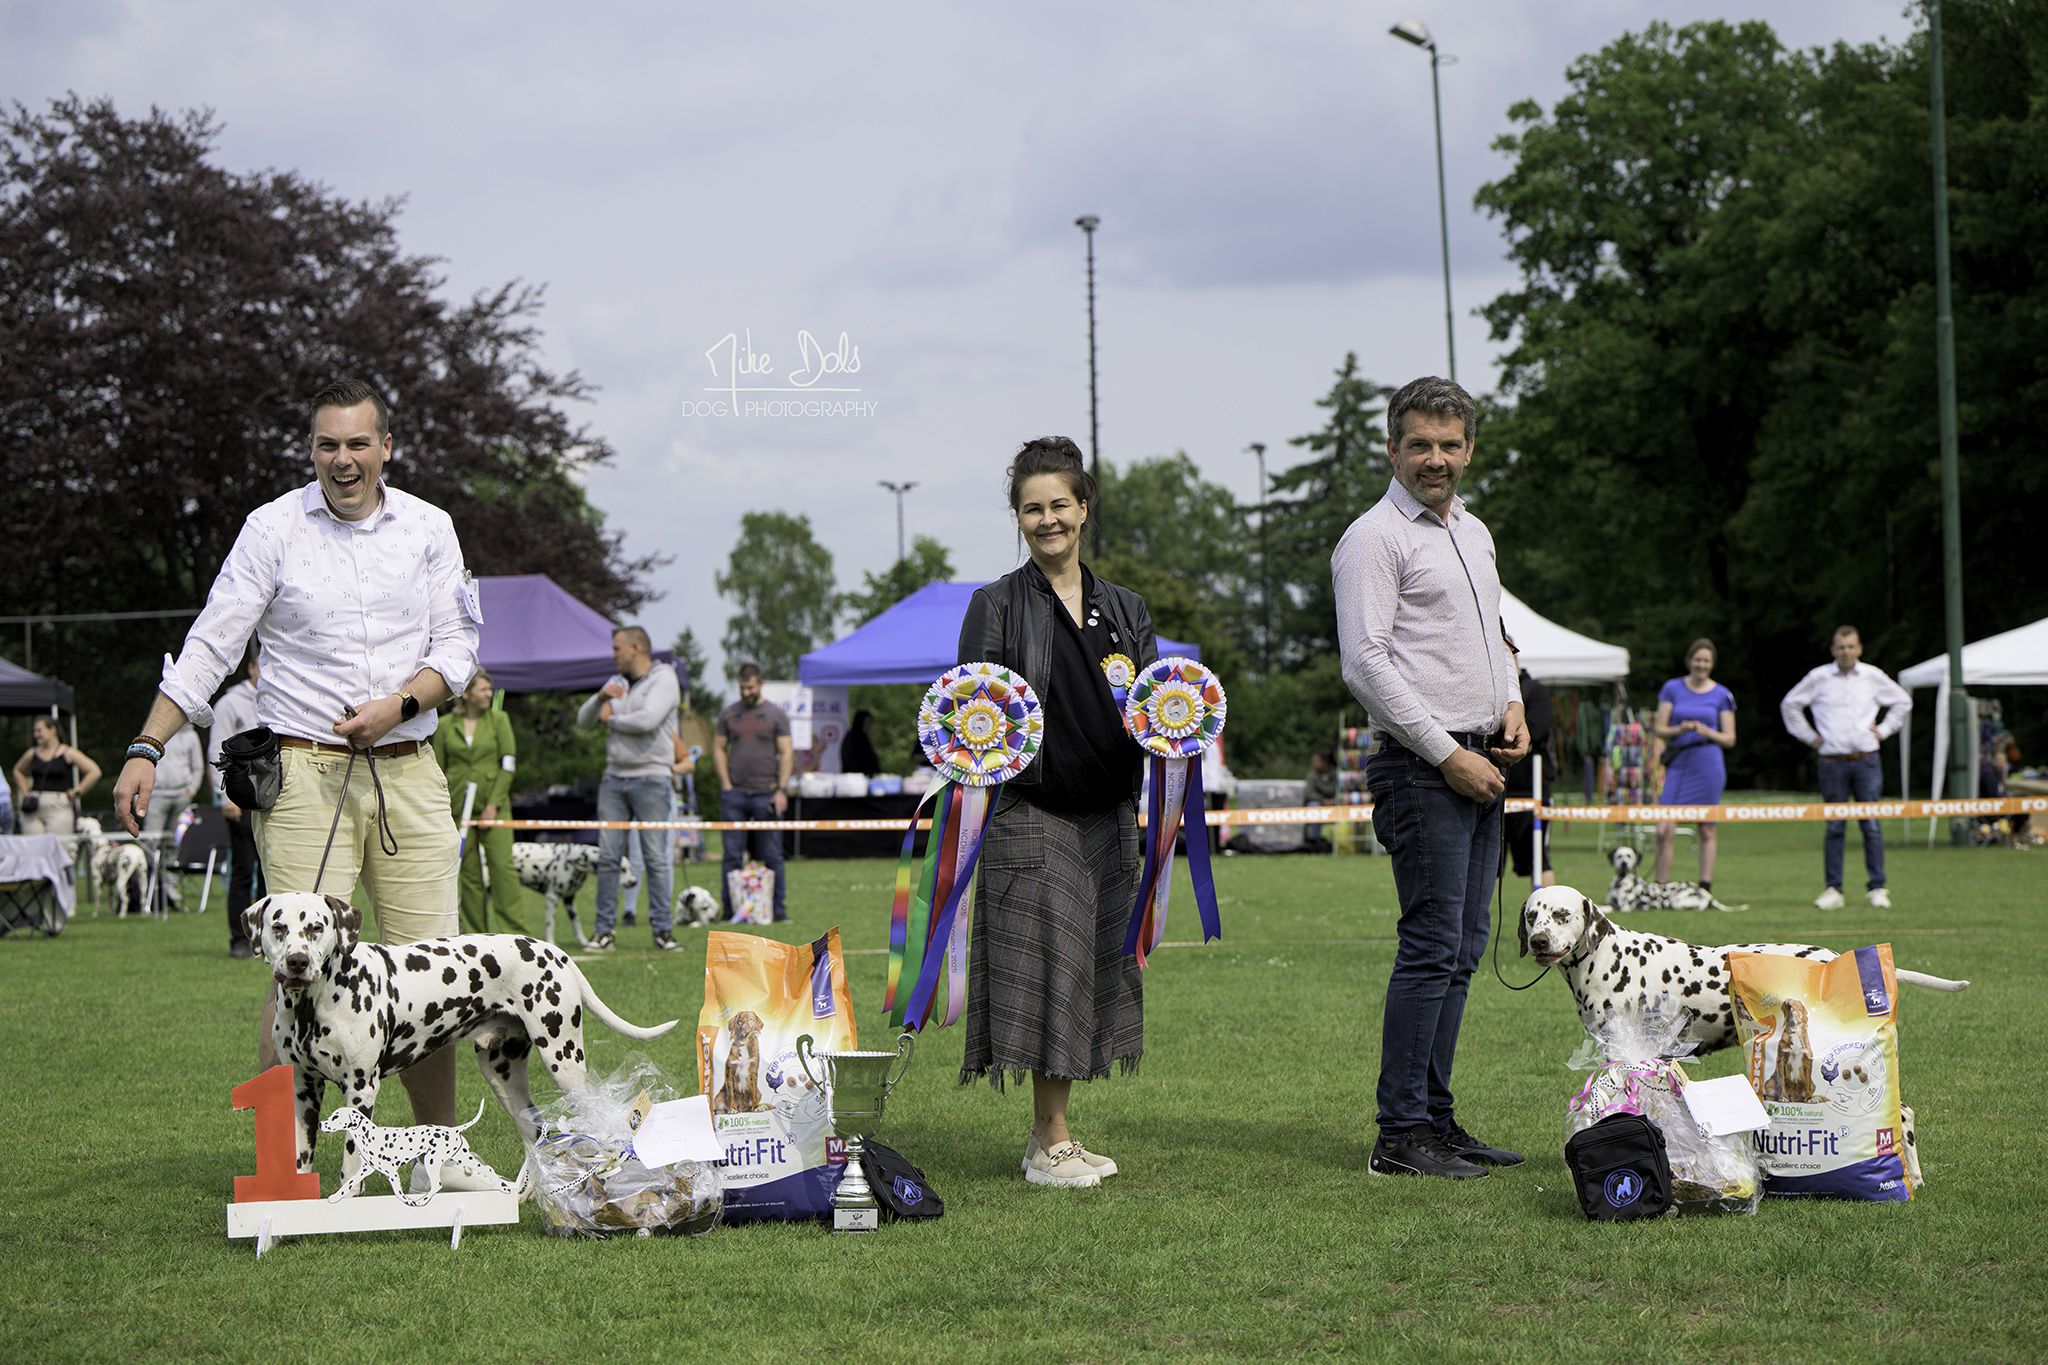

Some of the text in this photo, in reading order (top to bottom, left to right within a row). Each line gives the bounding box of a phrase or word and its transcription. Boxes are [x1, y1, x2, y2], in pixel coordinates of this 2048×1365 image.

[1167, 772, 1175, 797] NCDH
[1177, 772, 1186, 789] BOS
[959, 828, 968, 853] NCDH
[970, 829, 979, 846] BOB
[960, 898, 968, 917] 2025
[1825, 1041, 1866, 1066] KIP CHICKEN
[769, 1060, 780, 1074] KIP
[1780, 1106, 1824, 1117] 100% natural
[730, 1116, 751, 1128] 100%
[231, 1064, 321, 1204] 1
[1752, 1129, 1840, 1156] Nutri-Fit
[1879, 1131, 1892, 1146] M
[712, 1138, 786, 1168] utri-Fit
[829, 1139, 843, 1153] M
[1770, 1161, 1821, 1170] Excellent choice
[749, 1171, 769, 1180] choice
